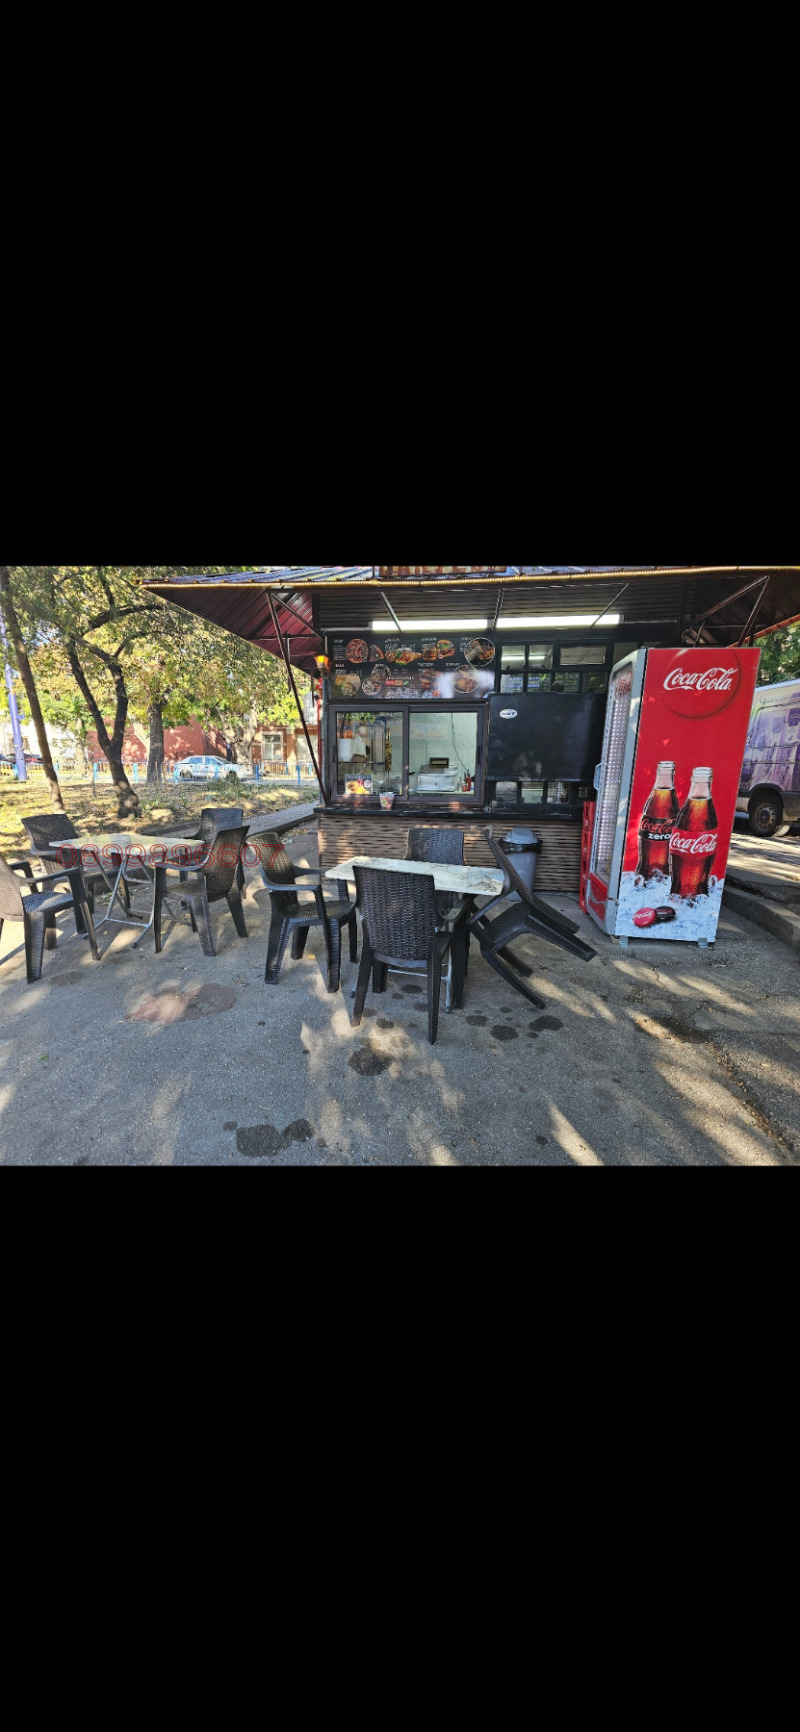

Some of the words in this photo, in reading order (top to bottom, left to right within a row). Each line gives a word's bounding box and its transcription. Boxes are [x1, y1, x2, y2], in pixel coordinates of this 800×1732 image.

[663, 667, 739, 691] Coca-Cola
[641, 818, 676, 834] Coca-Co
[648, 832, 671, 840] zero
[669, 832, 718, 854] Coca-Cola
